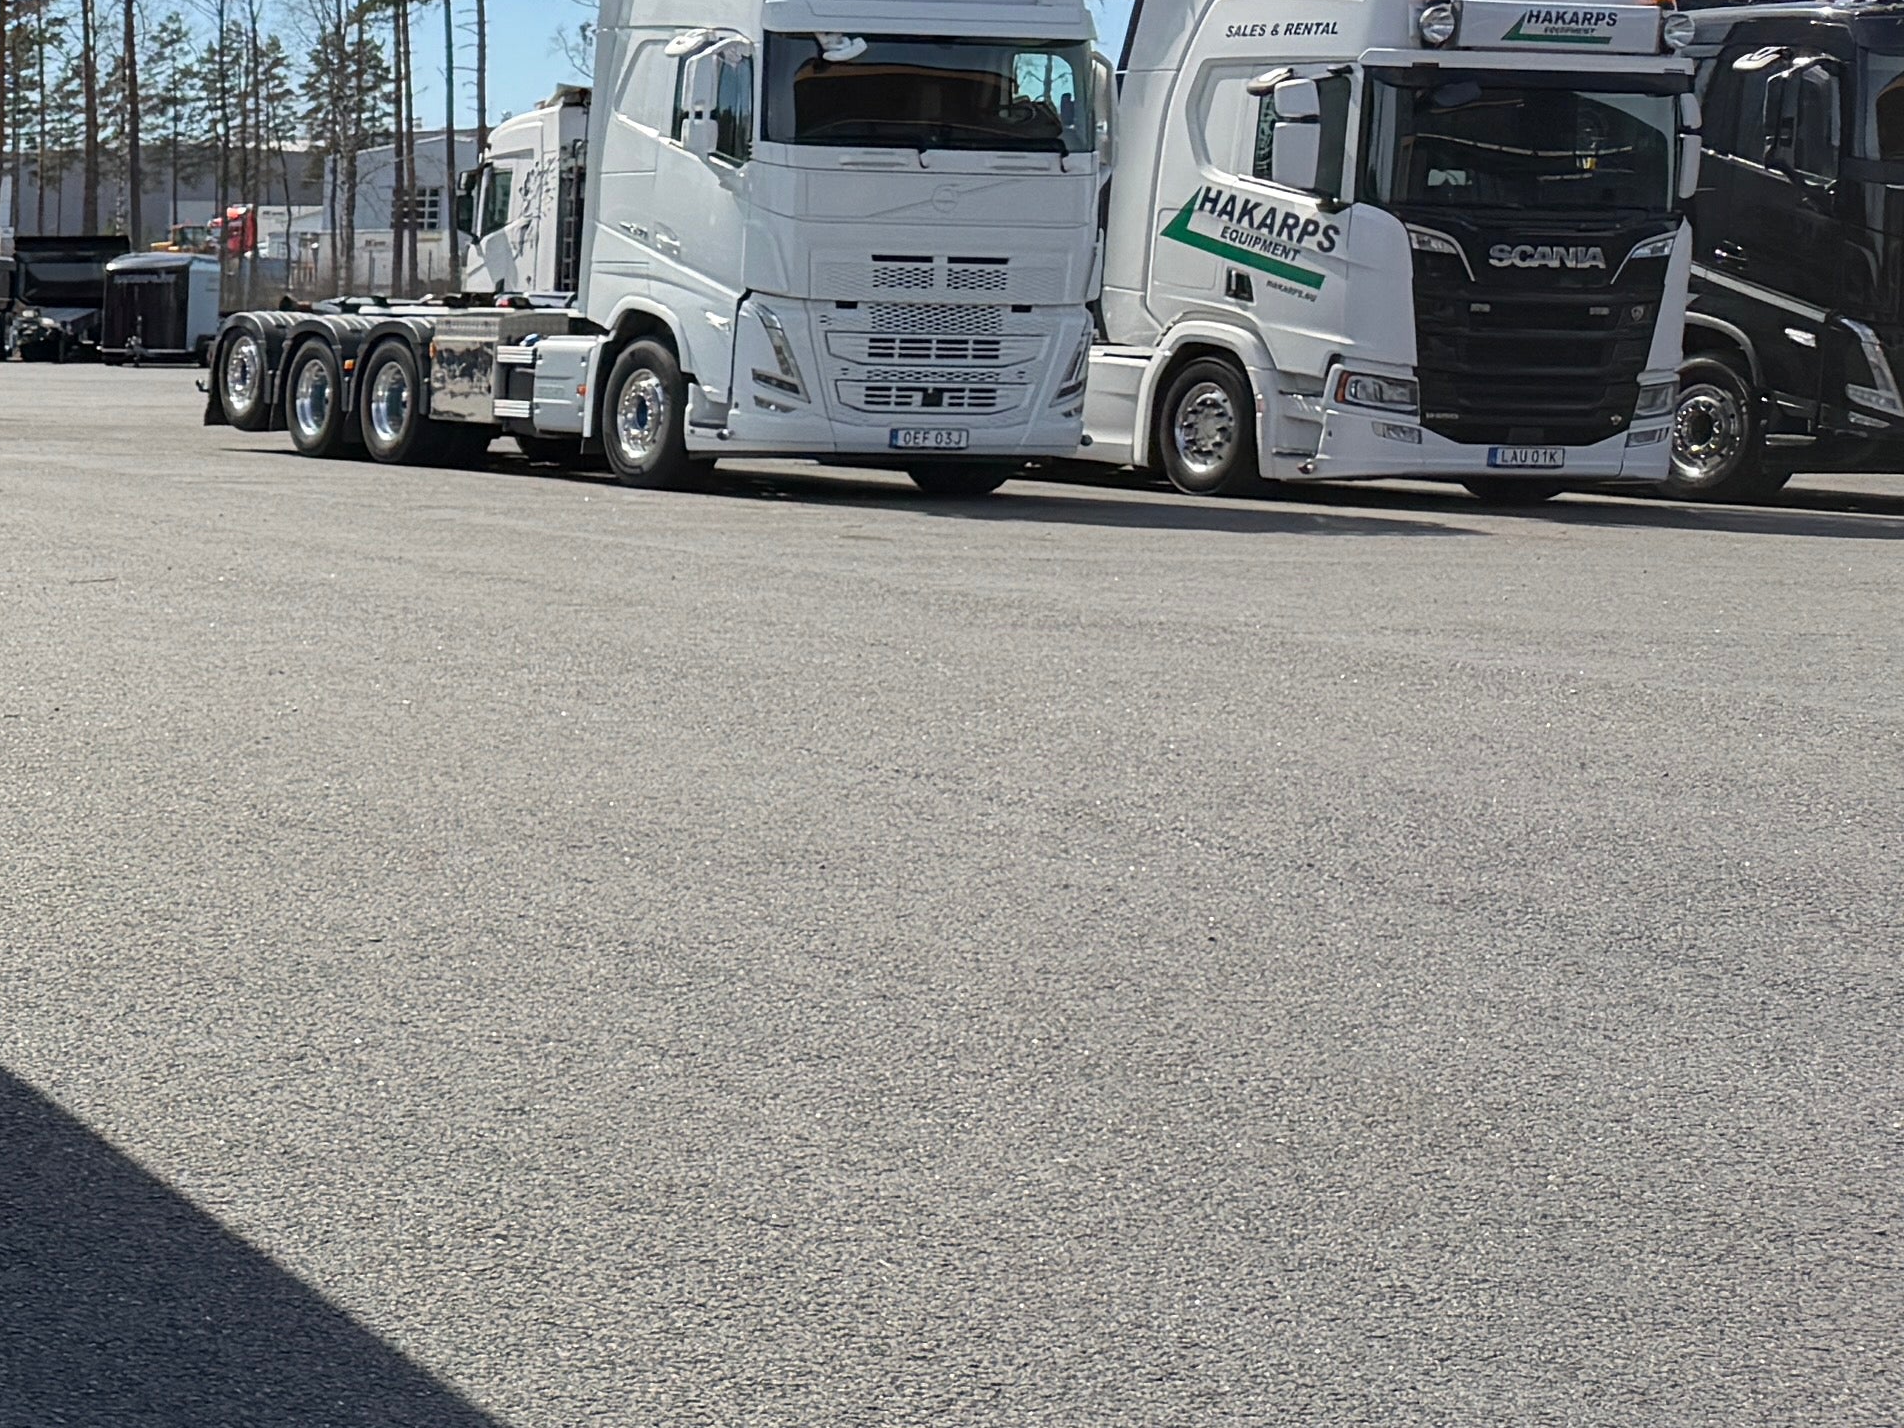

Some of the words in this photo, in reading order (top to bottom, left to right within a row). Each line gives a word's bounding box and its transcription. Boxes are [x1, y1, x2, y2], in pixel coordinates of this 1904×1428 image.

[1527, 9, 1618, 27] HAKARPS
[1225, 24, 1267, 38] SALES
[1270, 23, 1280, 36] &
[1284, 21, 1339, 36] RENTAL
[1198, 186, 1341, 253] HAKARPS
[1220, 226, 1301, 262] EQUIPMENT
[1489, 244, 1606, 269] SCANIA
[903, 431, 931, 445] OEF
[935, 431, 962, 445] 03J
[1501, 449, 1528, 463] LAU
[1531, 450, 1558, 463] 01K
